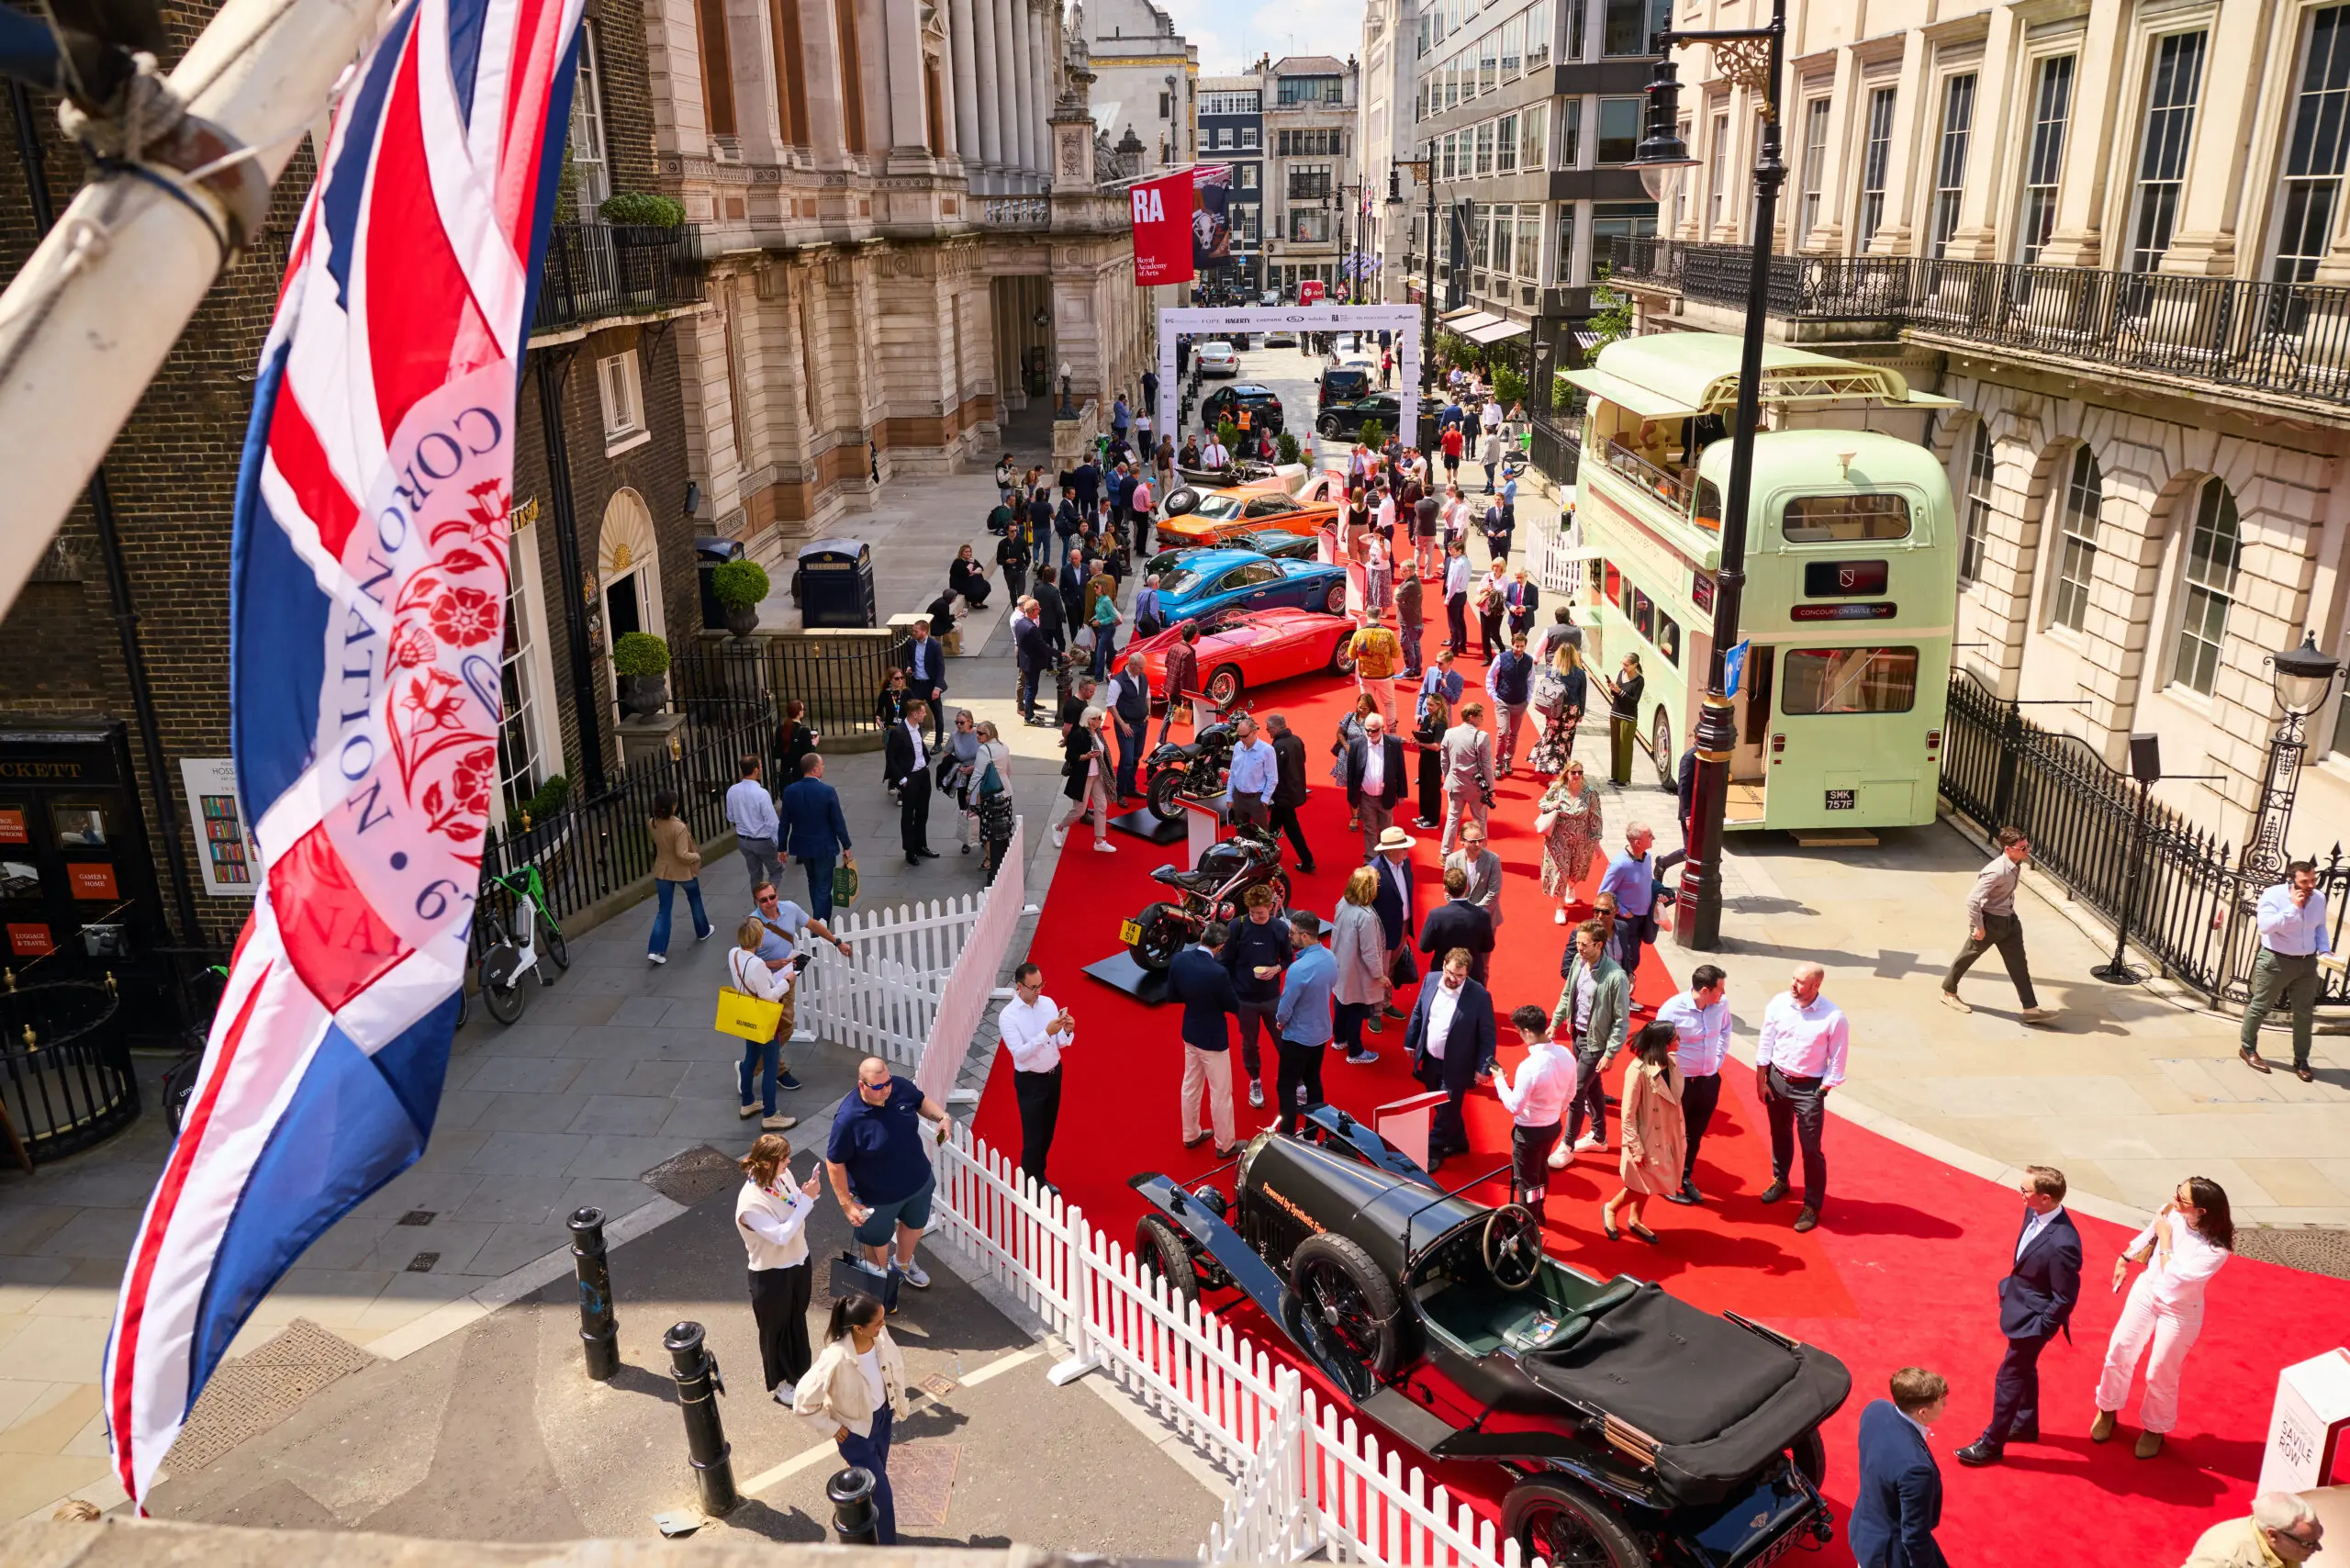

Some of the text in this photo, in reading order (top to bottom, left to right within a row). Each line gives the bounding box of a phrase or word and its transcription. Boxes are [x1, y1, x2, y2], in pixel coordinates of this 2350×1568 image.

[1133, 189, 1165, 223] RA
[1137, 256, 1155, 264] Royal
[1331, 314, 1339, 322] RA
[340, 407, 502, 835] CORONATION
[0, 762, 82, 778] CKETT
[1830, 790, 1850, 800] SMK
[1827, 801, 1853, 810] 757F
[1127, 923, 1136, 933] V4
[1125, 932, 1135, 942] SV
[735, 1019, 757, 1030] SELFRIDGES
[1262, 1182, 1327, 1234] Powered by Synthetic Fuel
[2281, 1420, 2312, 1465] SAVILE
[2278, 1436, 2300, 1467] ROW
